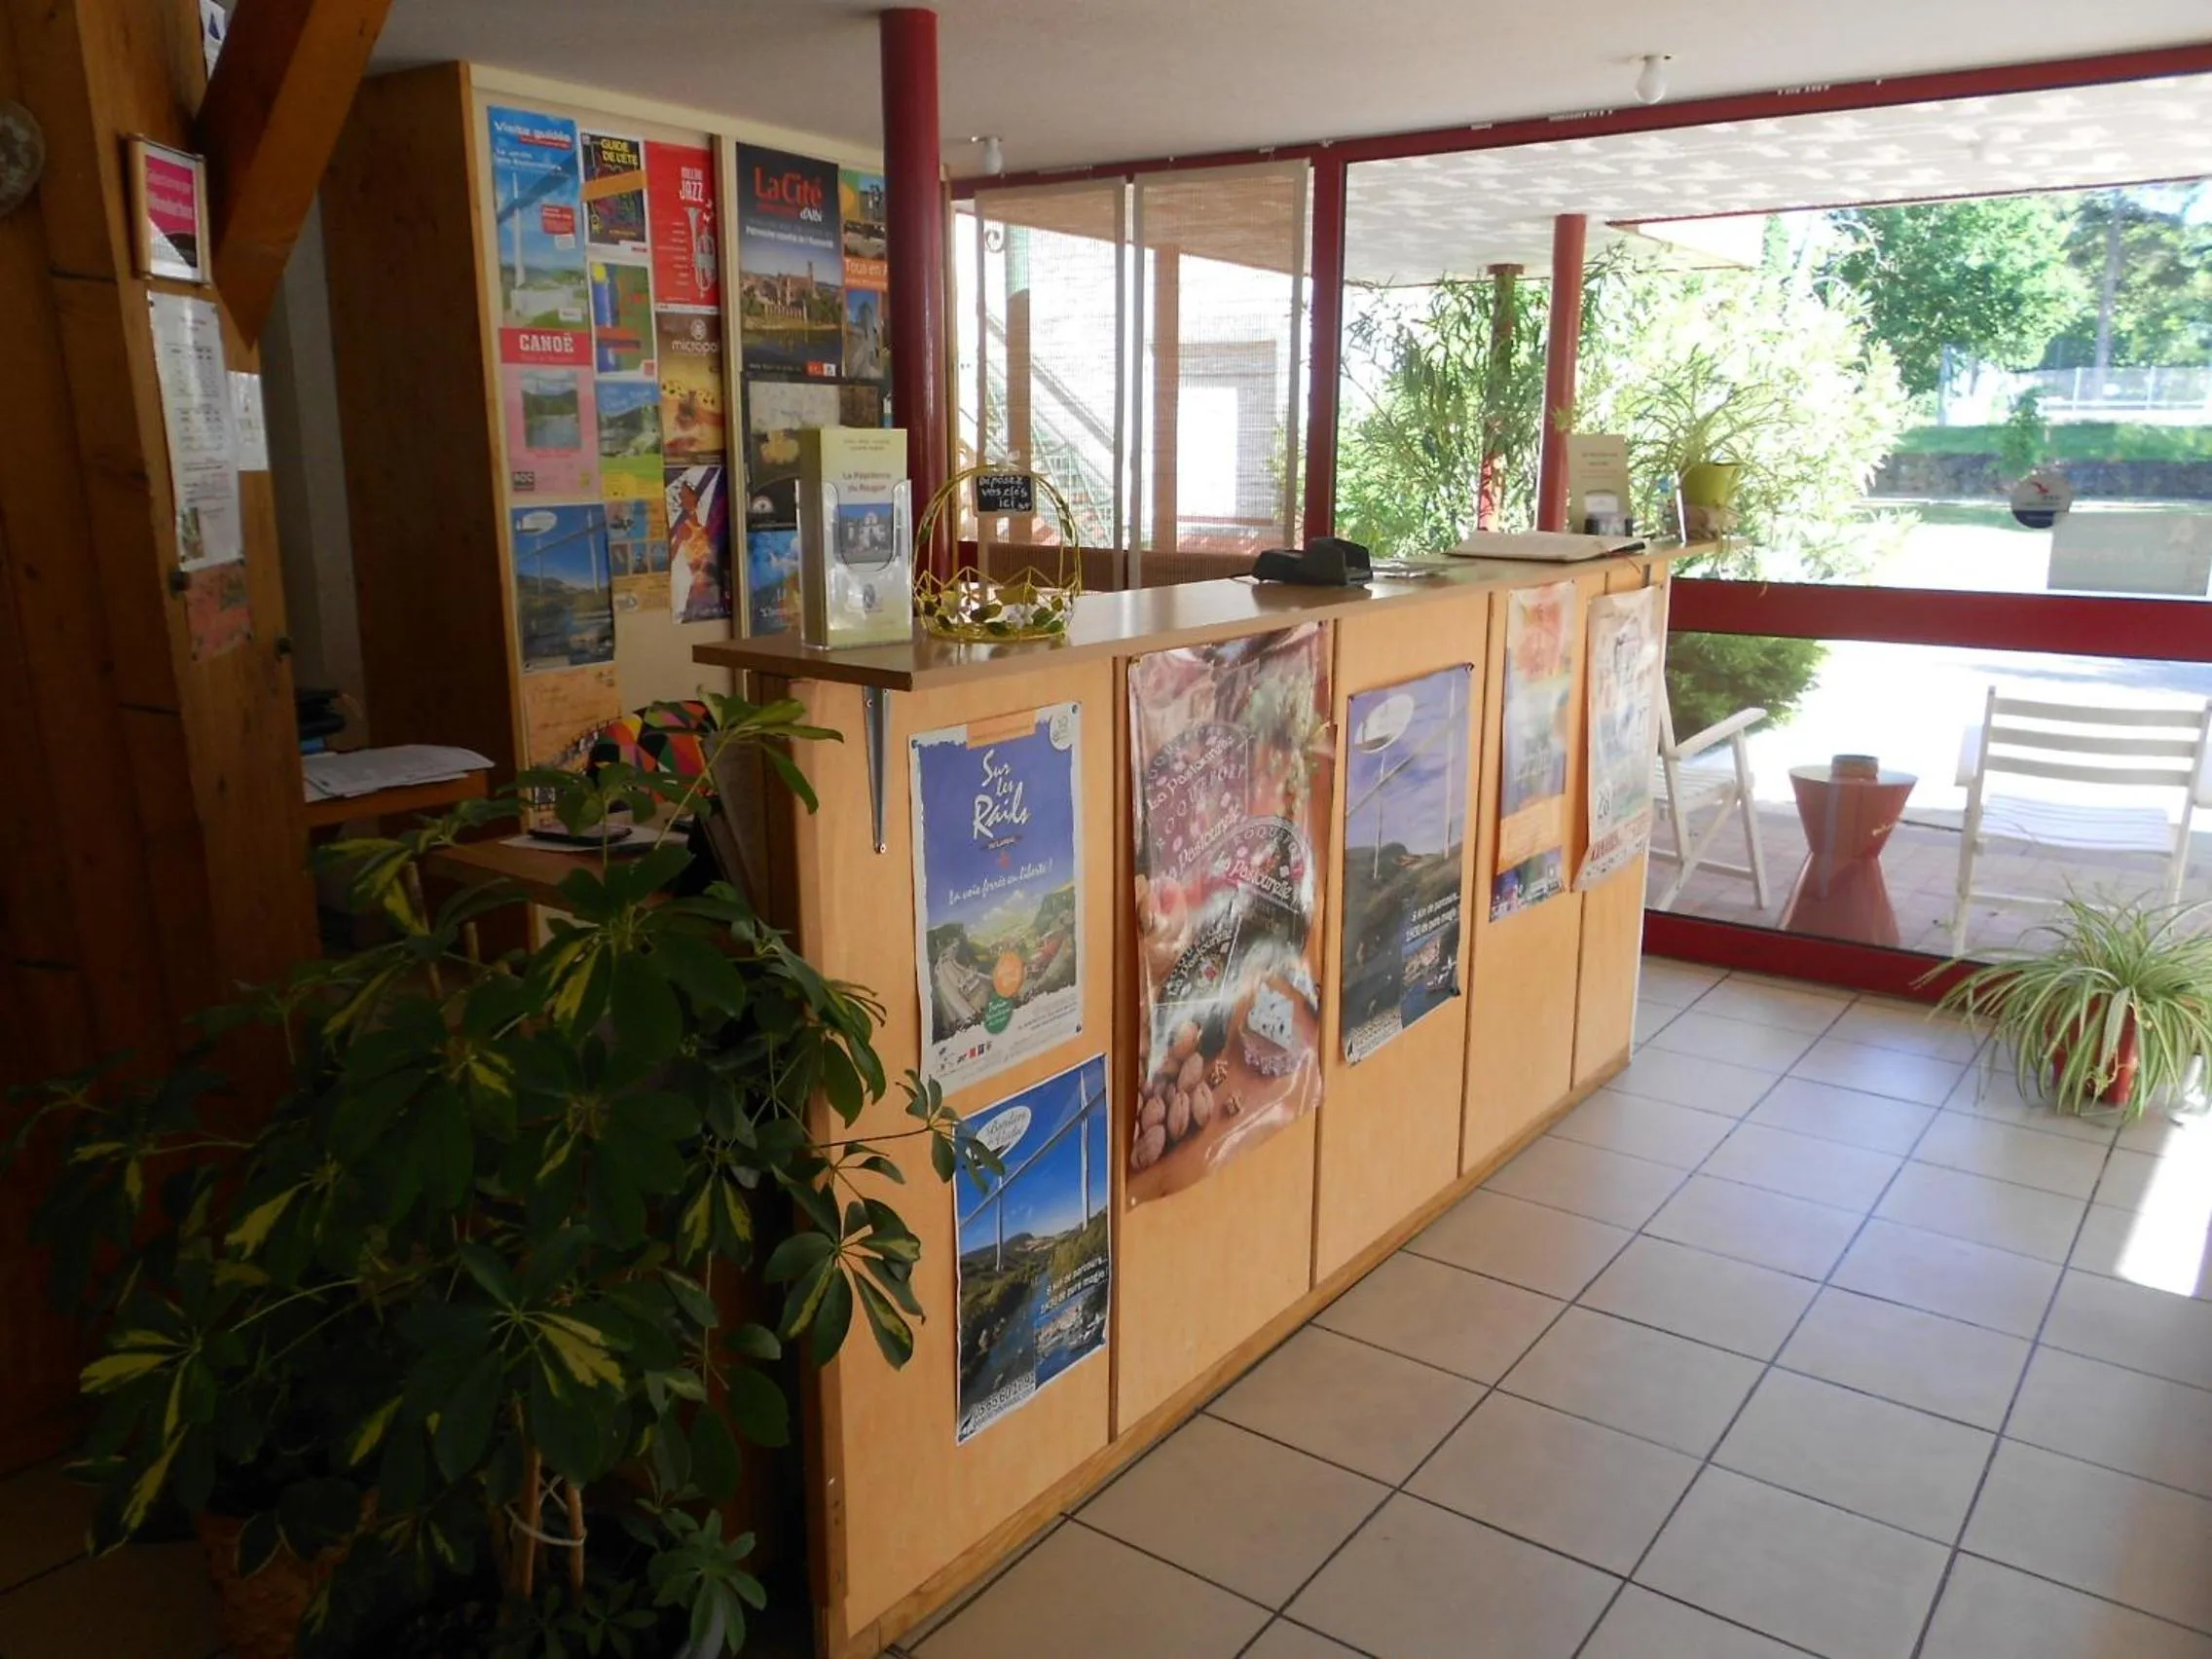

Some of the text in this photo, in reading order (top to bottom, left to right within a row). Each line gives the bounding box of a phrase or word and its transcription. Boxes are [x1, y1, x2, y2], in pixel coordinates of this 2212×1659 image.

[601, 138, 629, 152] GUIDE
[679, 180, 704, 203] JAZZ
[519, 333, 573, 352] CANOË
[981, 749, 1012, 787] Sur
[996, 777, 1014, 796] les
[973, 781, 1032, 840] Rails
[1147, 791, 1167, 812] La
